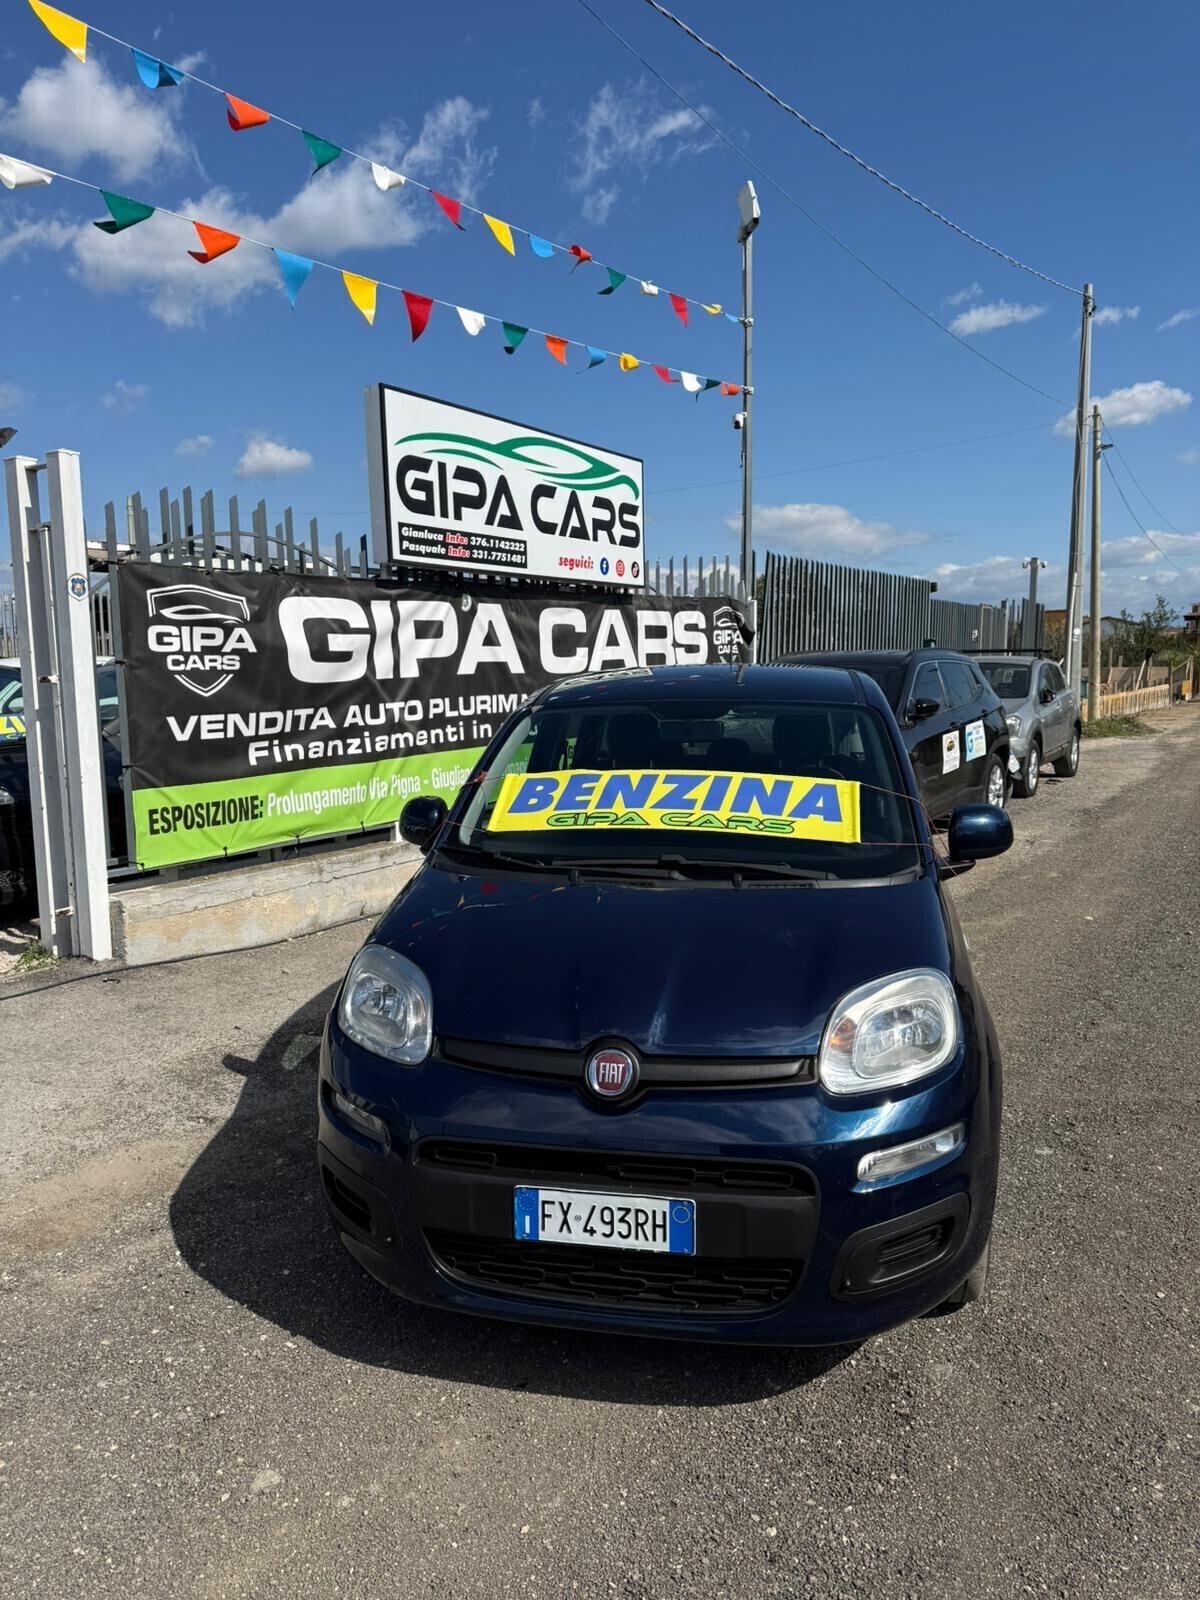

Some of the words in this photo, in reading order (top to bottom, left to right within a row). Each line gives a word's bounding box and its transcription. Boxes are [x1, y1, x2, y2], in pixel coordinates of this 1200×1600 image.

[396, 454, 524, 531] GIPA
[530, 483, 640, 549] CARS
[401, 526, 444, 541] Gianluca
[445, 532, 468, 545] Info:
[470, 536, 525, 552] 376.1142322
[402, 540, 446, 556] Pasquale
[447, 546, 470, 558] Info:
[472, 550, 526, 564] 331.7751481
[558, 555, 594, 570] seguici:
[147, 625, 258, 653] GIPA
[278, 596, 525, 684] GIPA
[539, 607, 708, 674] CARS
[166, 654, 241, 671] CARS
[166, 707, 337, 742] VENDITA
[343, 700, 424, 728] AUTO
[248, 720, 465, 766] Finanziamenti
[473, 719, 493, 740] in
[148, 795, 264, 836] ESPOSIZIONE:
[267, 781, 367, 817] Prolungamento
[369, 776, 388, 799] Via
[390, 773, 421, 799] Pigna
[431, 764, 474, 791] Giuglian
[507, 774, 843, 822] BENZINA
[546, 811, 651, 827] GIPA
[660, 812, 796, 834] CARS
[599, 1062, 625, 1083] FIAT
